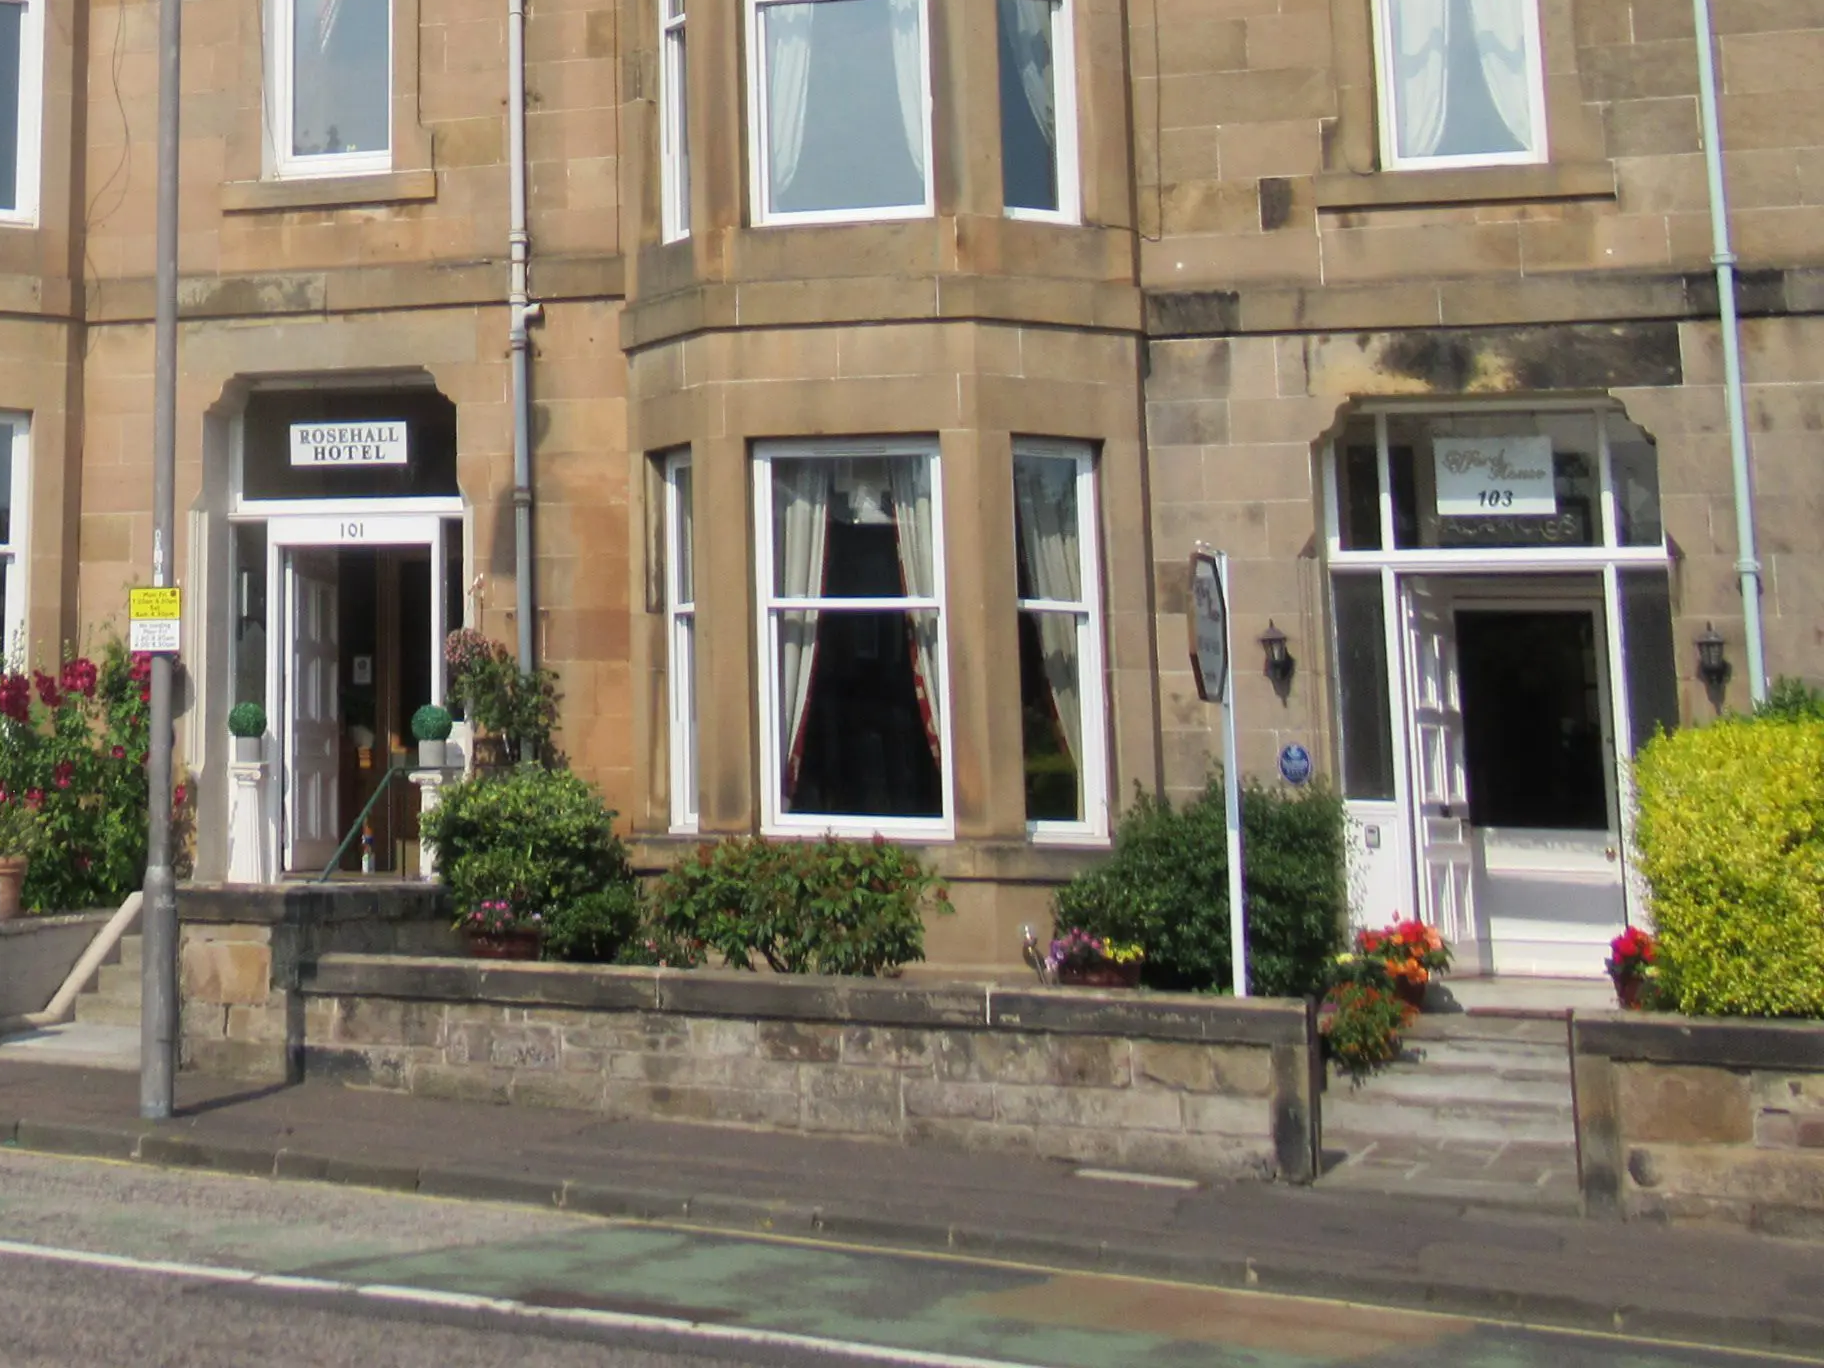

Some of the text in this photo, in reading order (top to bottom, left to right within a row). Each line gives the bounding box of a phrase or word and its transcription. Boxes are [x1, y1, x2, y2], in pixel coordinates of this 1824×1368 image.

[299, 426, 399, 445] ROSEHALL
[313, 444, 386, 461] HOTEL
[1478, 489, 1514, 508] 103
[340, 522, 364, 539] 101
